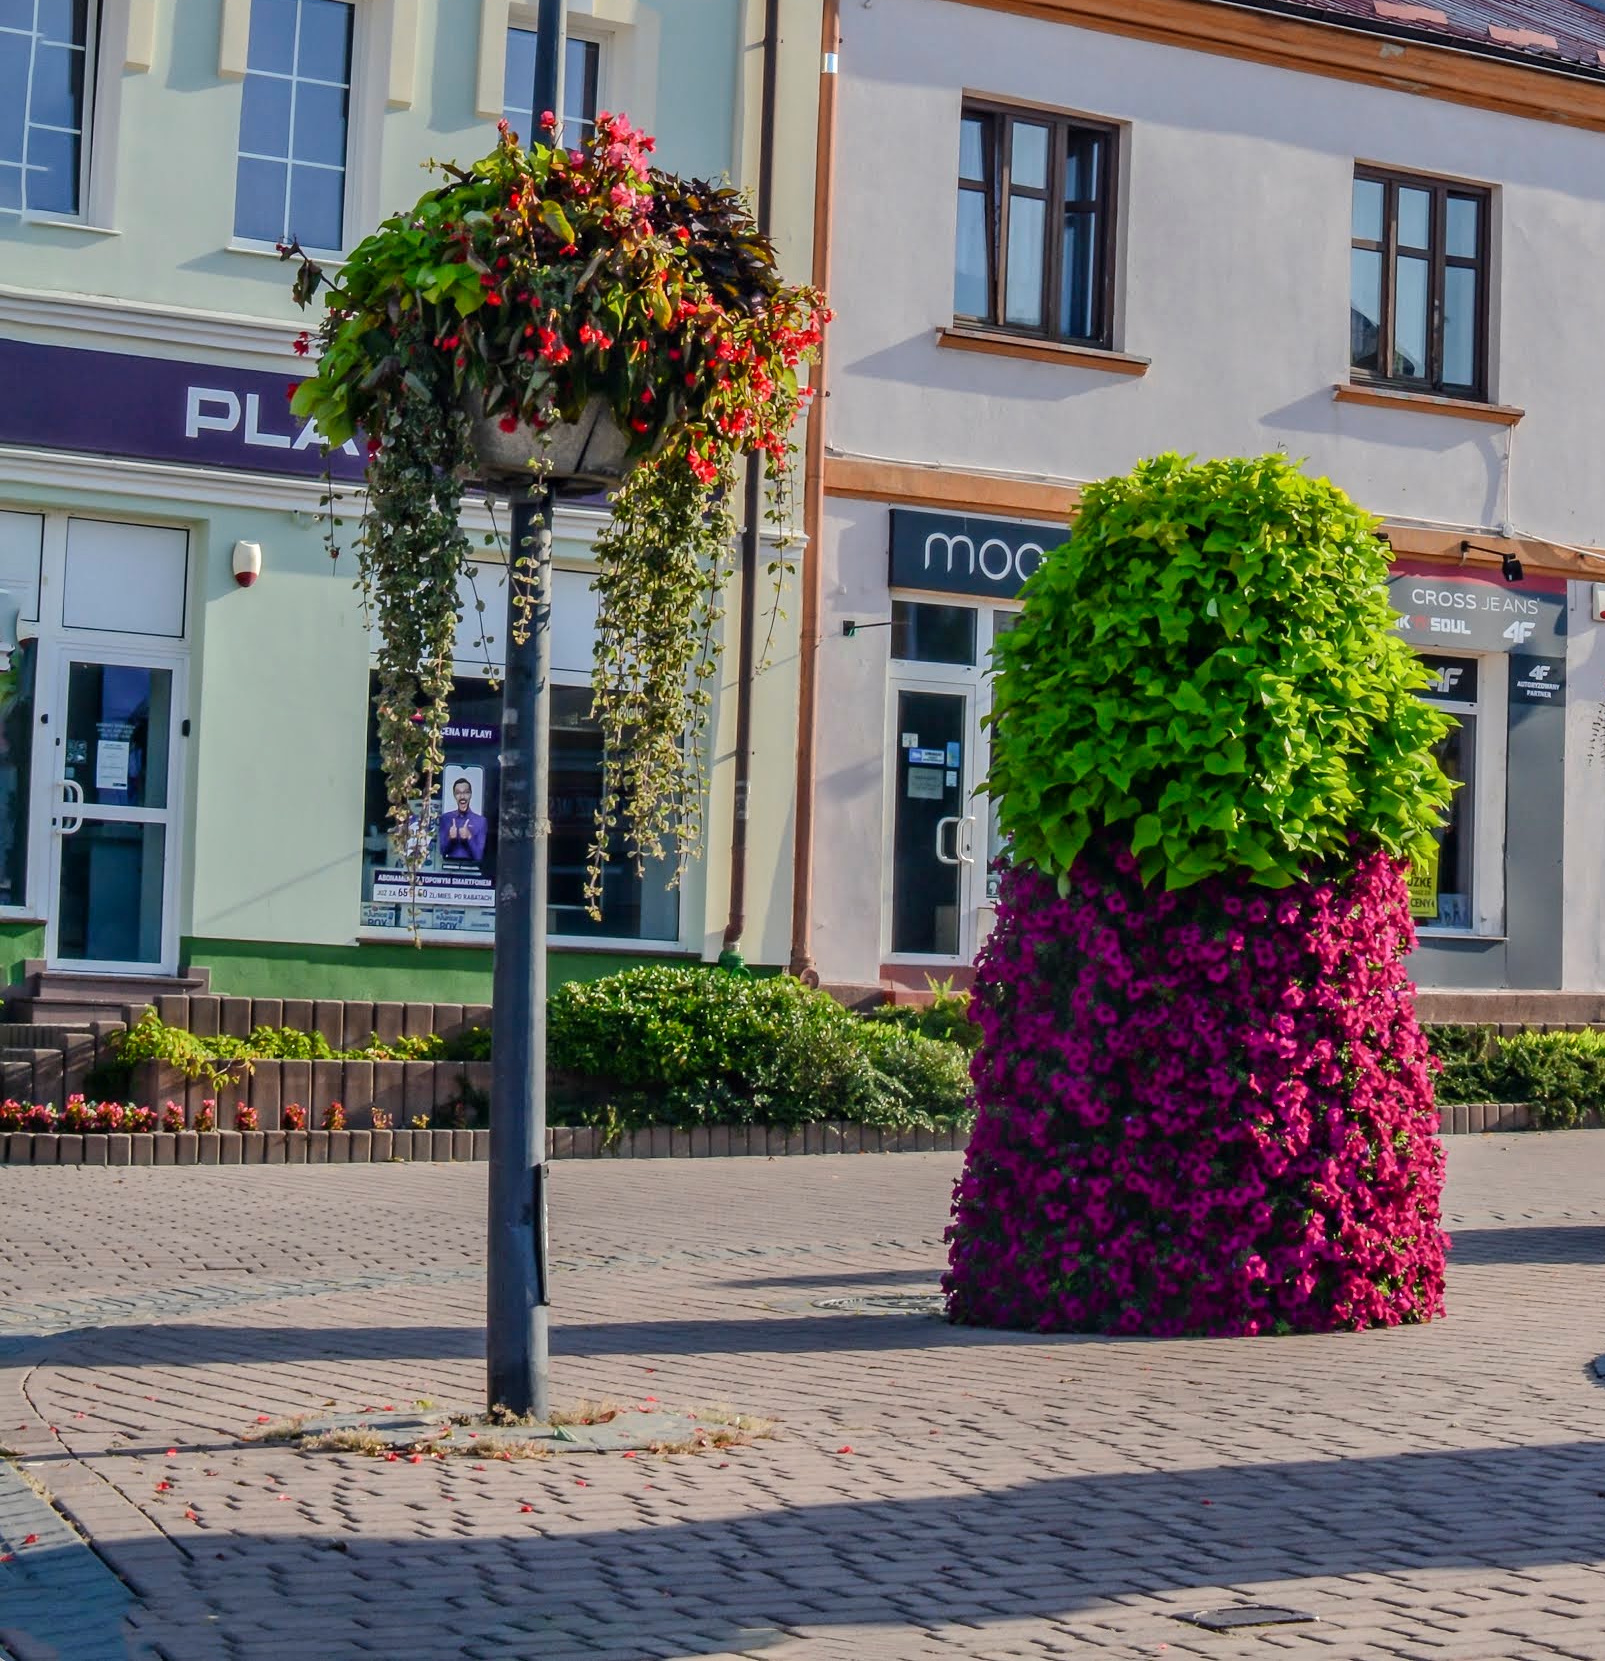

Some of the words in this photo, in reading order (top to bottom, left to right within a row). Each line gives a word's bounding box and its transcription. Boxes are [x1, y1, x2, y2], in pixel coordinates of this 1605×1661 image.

[1412, 589, 1477, 610] CROSS
[1430, 617, 1472, 635] SOUL
[1503, 620, 1536, 644] 4F
[1528, 665, 1551, 681] 4F
[462, 728, 469, 737] W
[470, 729, 492, 739] PLAY!
